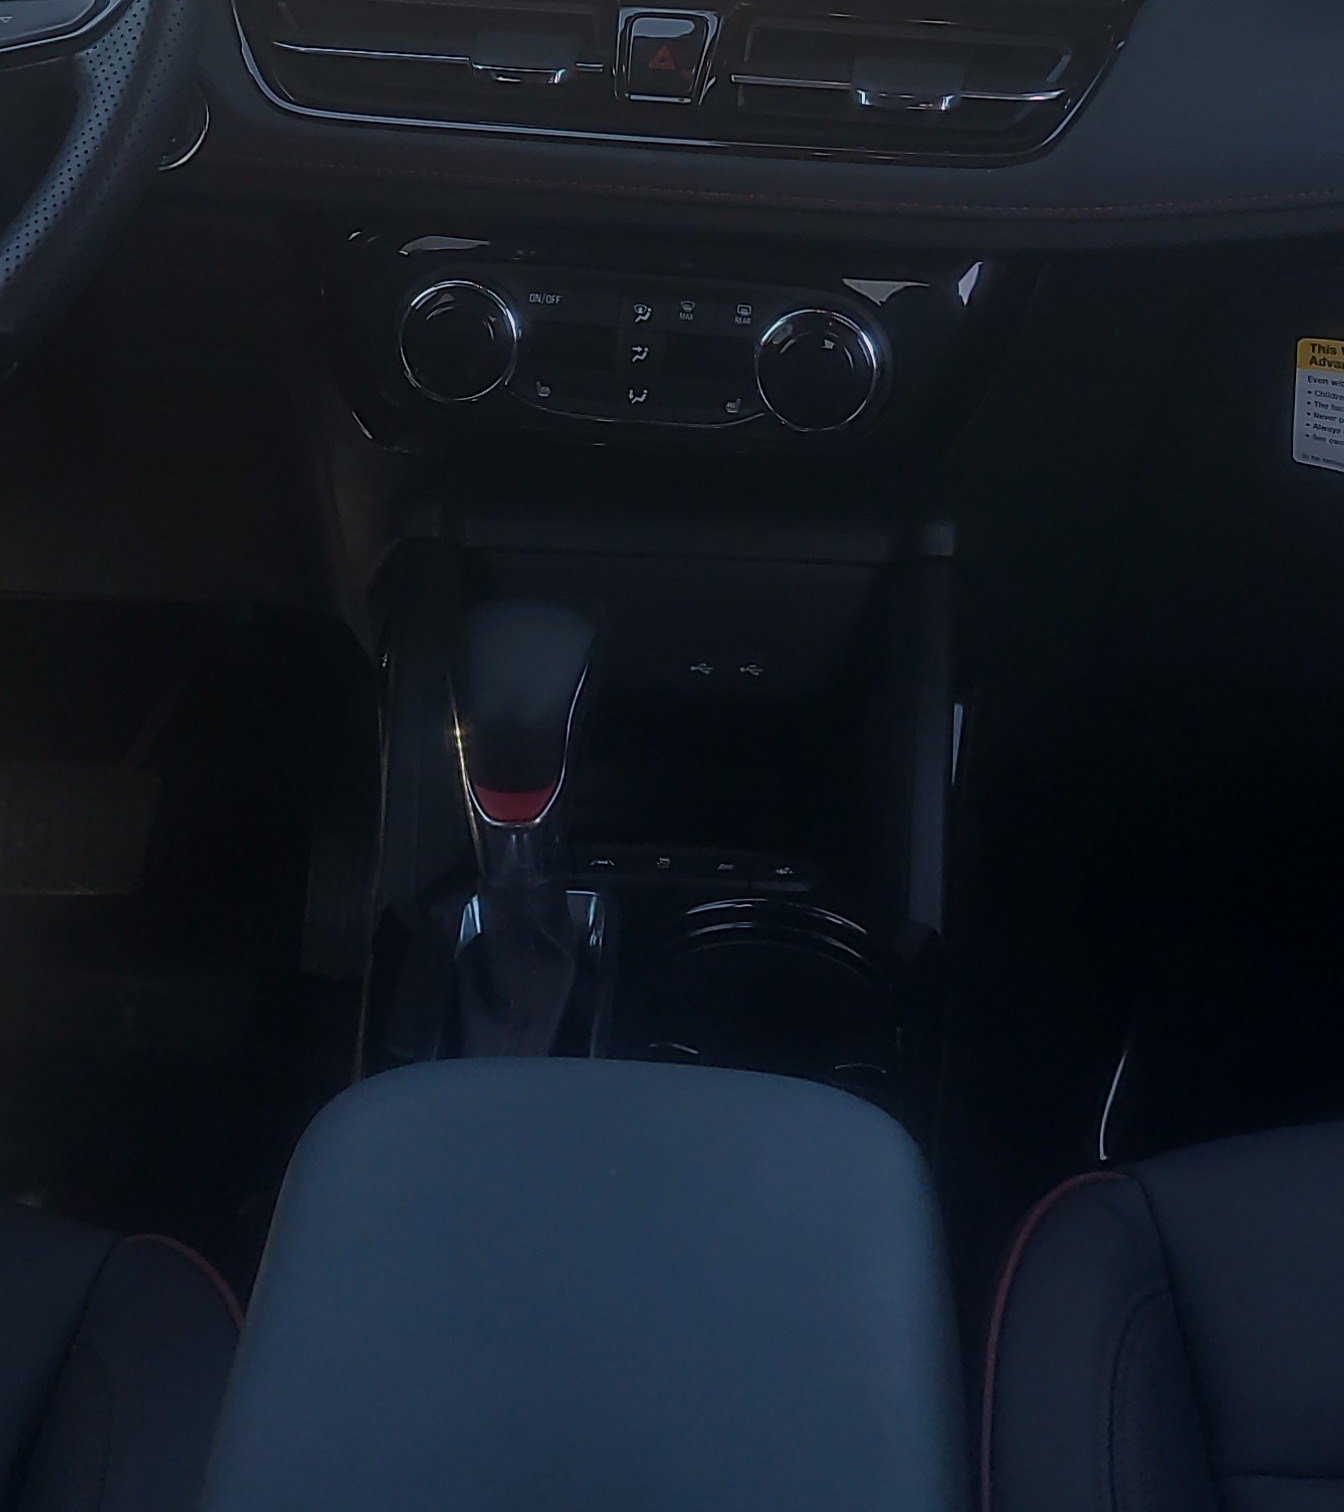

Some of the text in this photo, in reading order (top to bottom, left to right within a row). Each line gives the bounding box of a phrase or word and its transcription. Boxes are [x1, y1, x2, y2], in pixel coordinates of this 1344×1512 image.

[529, 292, 563, 305] ON/OFF
[1310, 343, 1337, 355] This
[1308, 375, 1328, 385] Even
